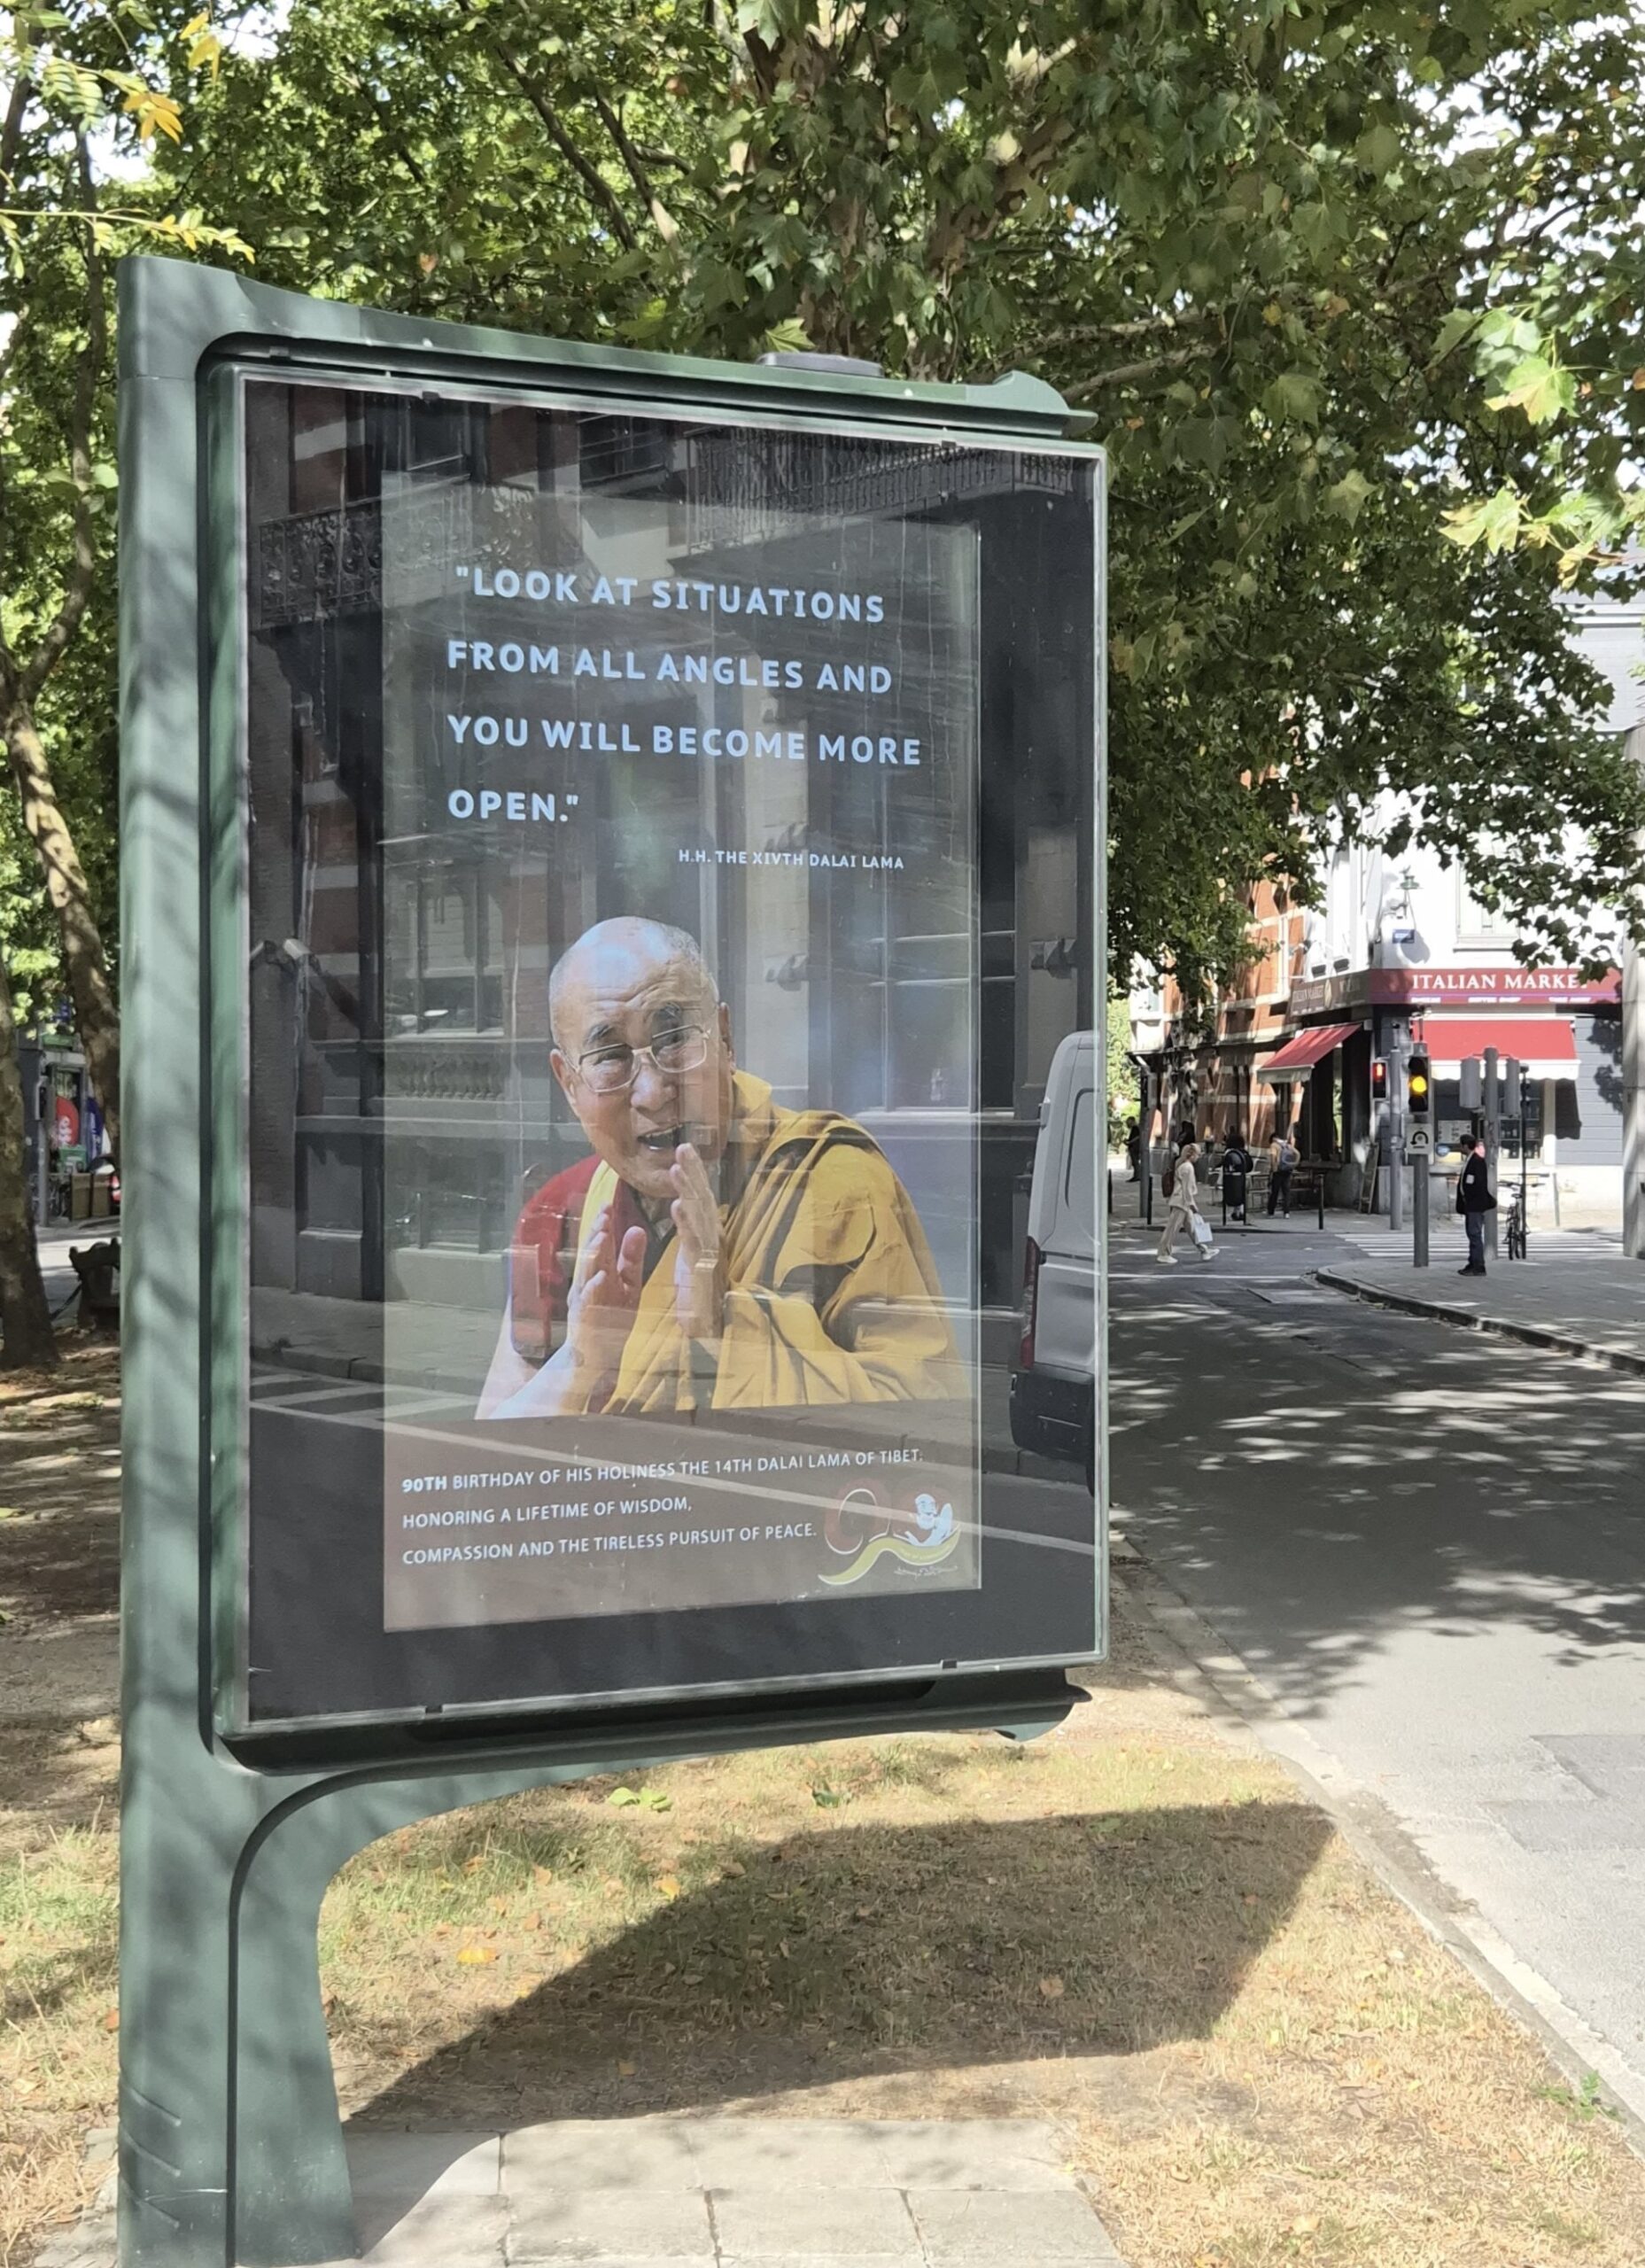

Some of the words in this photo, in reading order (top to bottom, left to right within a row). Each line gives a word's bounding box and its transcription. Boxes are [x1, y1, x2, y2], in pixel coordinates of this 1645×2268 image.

[456, 567, 578, 602] "LOOK
[591, 576, 637, 605] AT
[653, 580, 883, 622] SITUATIONS
[448, 640, 558, 674] FROM
[572, 649, 645, 680] ALL
[657, 654, 803, 688] ANGLES
[817, 664, 891, 693] AND
[447, 715, 527, 746] YOU
[541, 720, 640, 751] WILL
[654, 726, 803, 758] BECOME
[819, 734, 919, 765] MORE
[448, 789, 578, 821] OPEN."
[679, 850, 710, 862] H.H.
[715, 850, 747, 863] THE
[753, 850, 804, 865] XIVTH
[810, 854, 856, 867] DALAI
[863, 856, 904, 868] LAMA
[1413, 975, 1495, 989] ITALIAN
[1505, 975, 1588, 989] MARKE
[402, 1476, 446, 1492] 90TH
[454, 1472, 534, 1488] BIRTHDAY
[539, 1470, 560, 1484] OF
[567, 1466, 594, 1481] HIS
[596, 1462, 676, 1481] HOLINESS
[679, 1461, 709, 1475] THE
[716, 1459, 751, 1472] 14TH
[758, 1456, 803, 1471] DALAI
[809, 1453, 850, 1468] LAMA
[856, 1452, 874, 1465] OF
[403, 1509, 494, 1528] HONORING
[500, 1509, 510, 1522] A
[517, 1503, 588, 1521] LIFETIME
[594, 1502, 615, 1515] OF
[620, 1497, 691, 1513] WISDOM,
[403, 1544, 512, 1564] COMPASSION
[518, 1542, 554, 1556] AND
[559, 1538, 588, 1553] THE
[594, 1534, 663, 1550] TIRELESS
[670, 1528, 734, 1545] PURSUIT
[740, 1527, 759, 1541] OF
[765, 1523, 816, 1539] PEACE.
